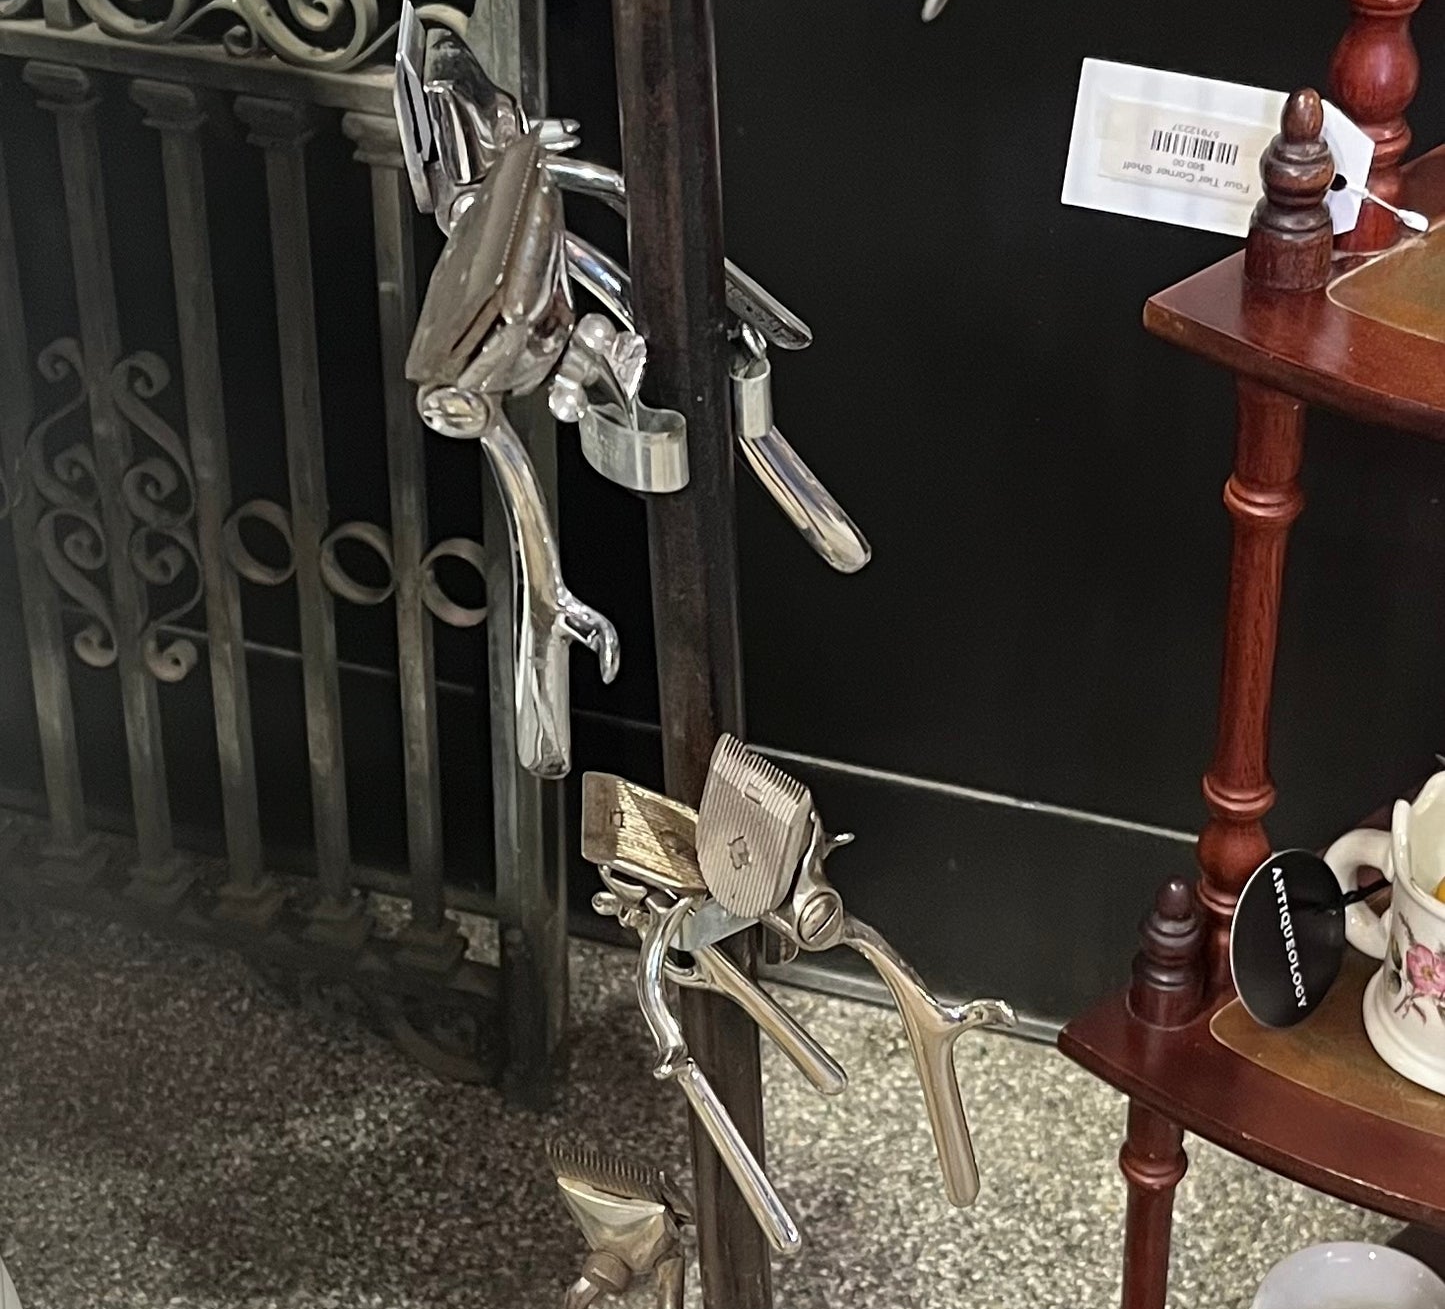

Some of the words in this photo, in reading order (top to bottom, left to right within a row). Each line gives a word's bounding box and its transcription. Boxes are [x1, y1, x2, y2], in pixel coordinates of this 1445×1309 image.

[1122, 160, 1152, 175] Shelf
[1155, 166, 1196, 183] Corner
[1198, 175, 1221, 188] Tier
[1223, 180, 1250, 194] Four
[1271, 867, 1307, 1007] ANTIQUEOLOGY
